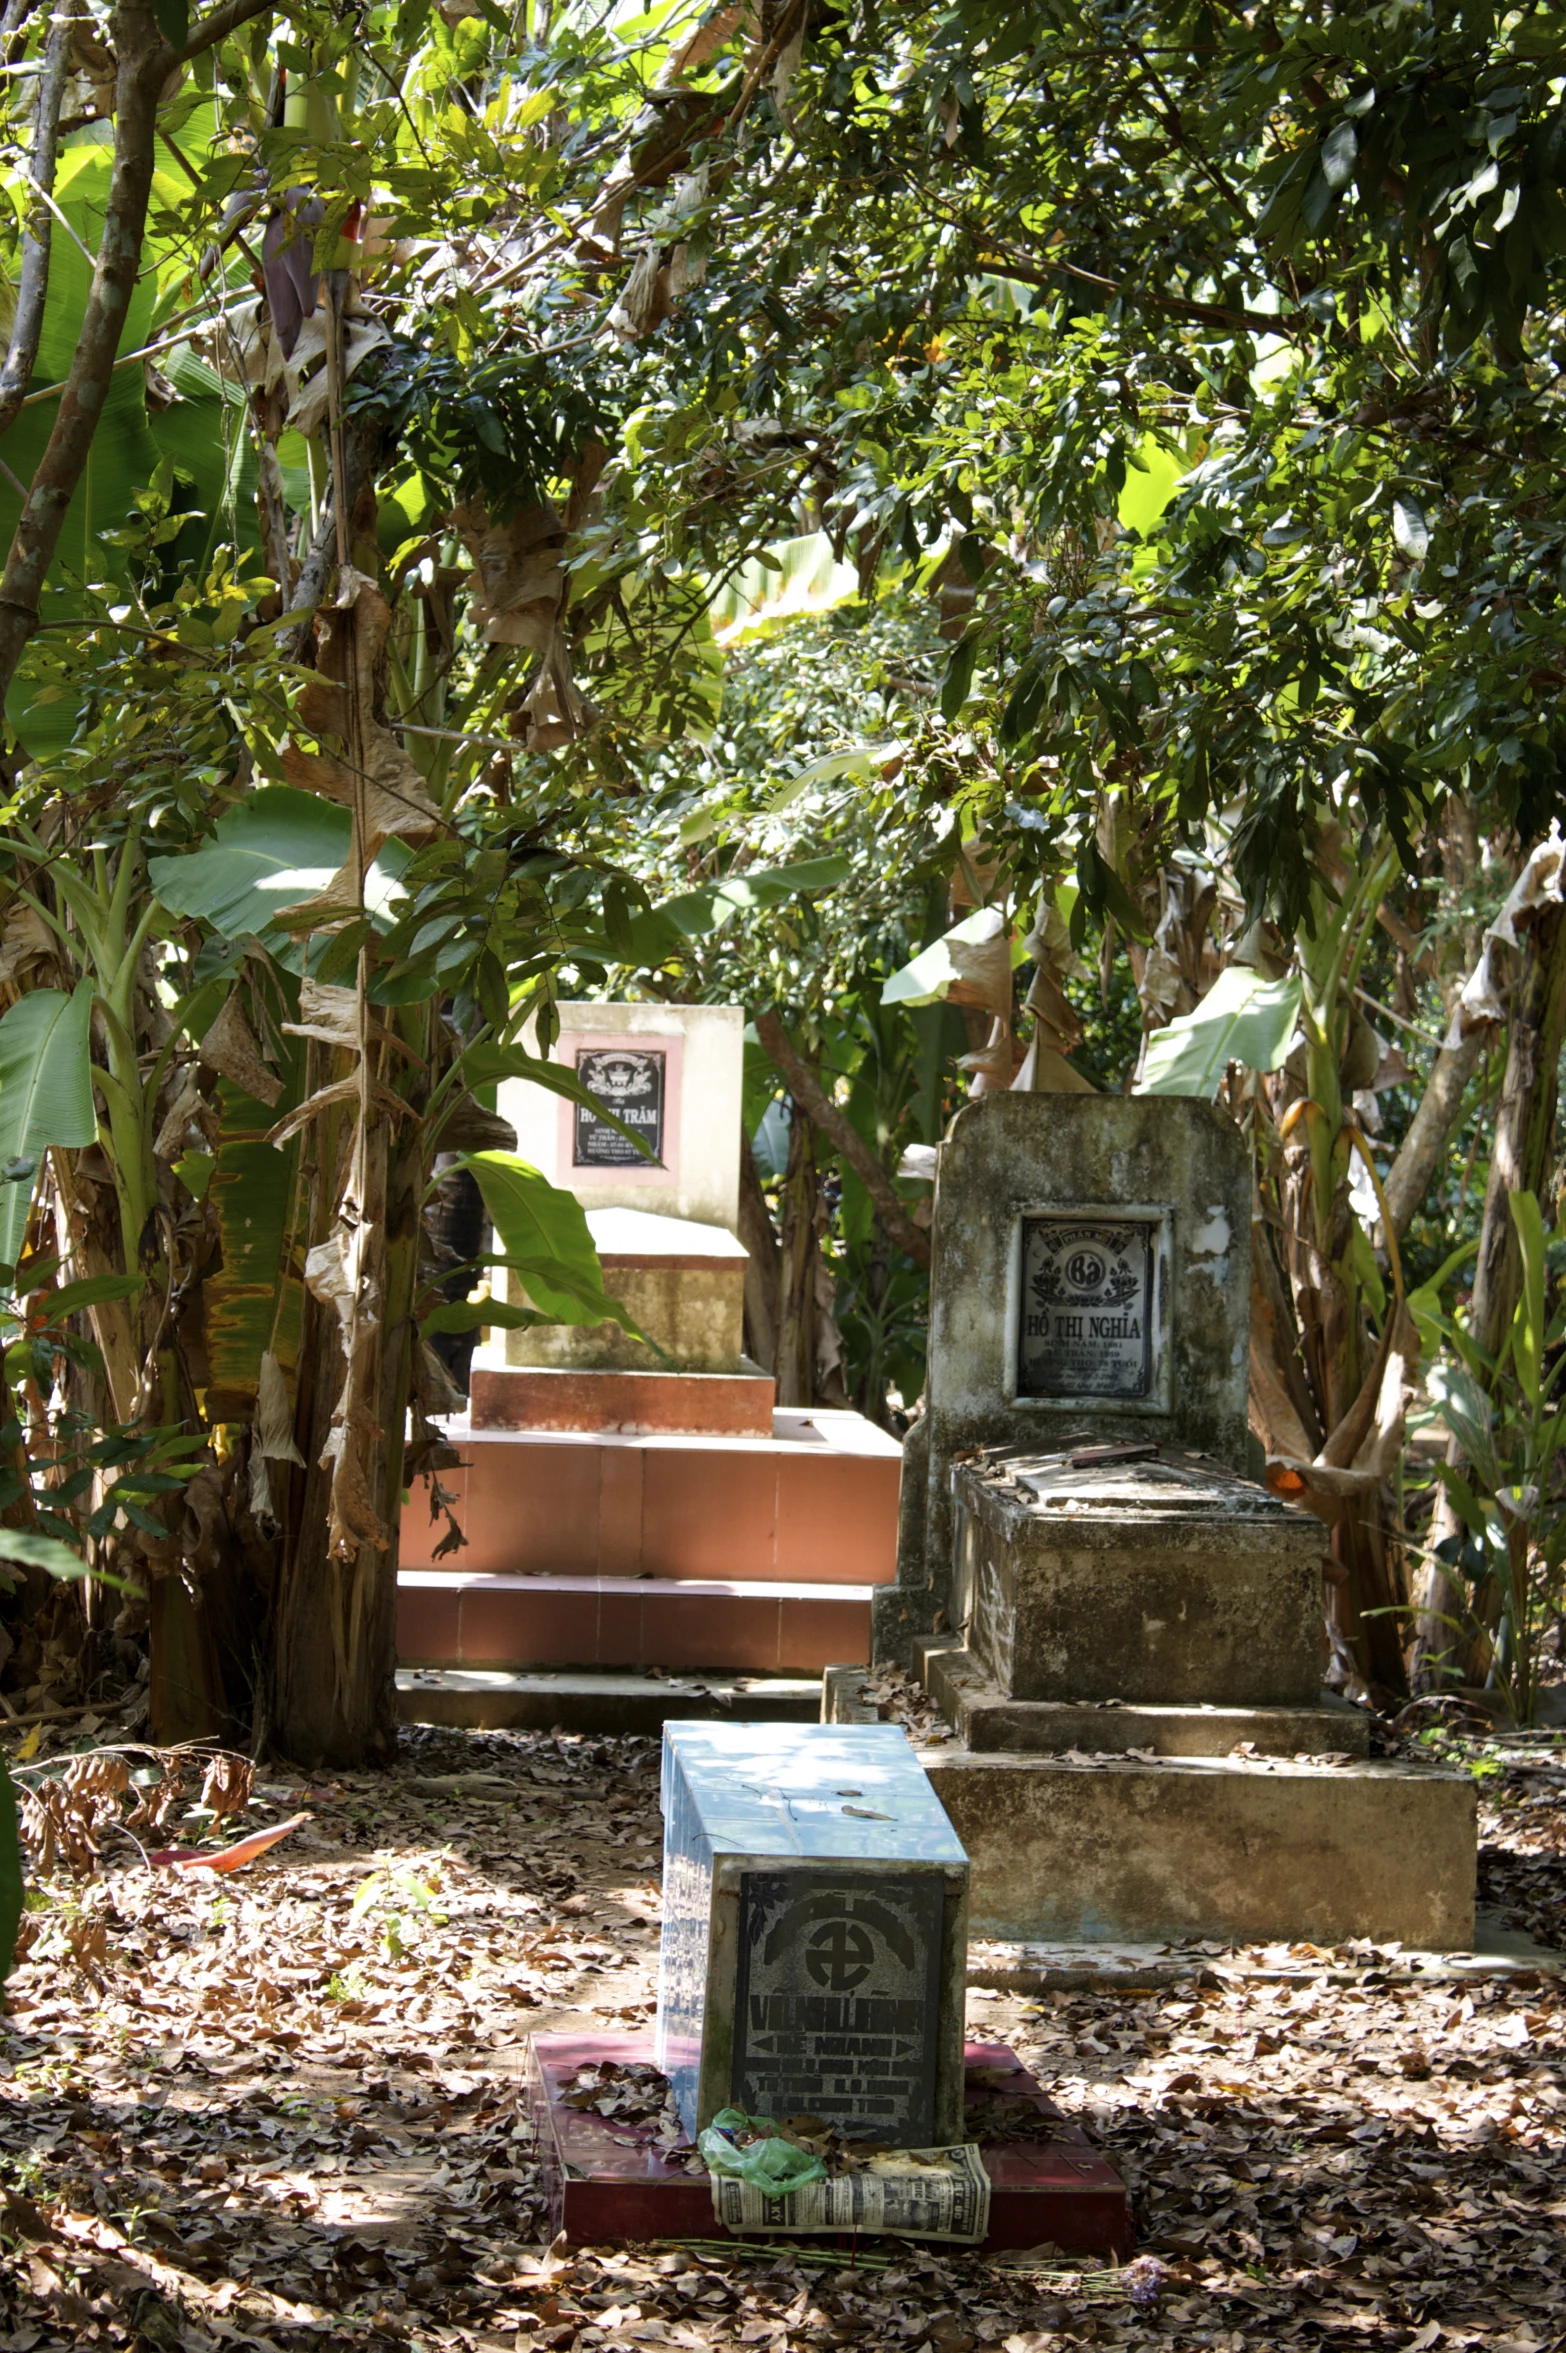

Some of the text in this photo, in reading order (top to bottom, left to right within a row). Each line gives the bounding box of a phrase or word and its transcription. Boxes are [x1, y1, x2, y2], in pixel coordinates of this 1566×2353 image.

[623, 1105, 657, 1125] TRĂM
[1070, 1255, 1101, 1286] Bà
[1027, 1307, 1141, 1340] HỒ THỊ NGHĨA
